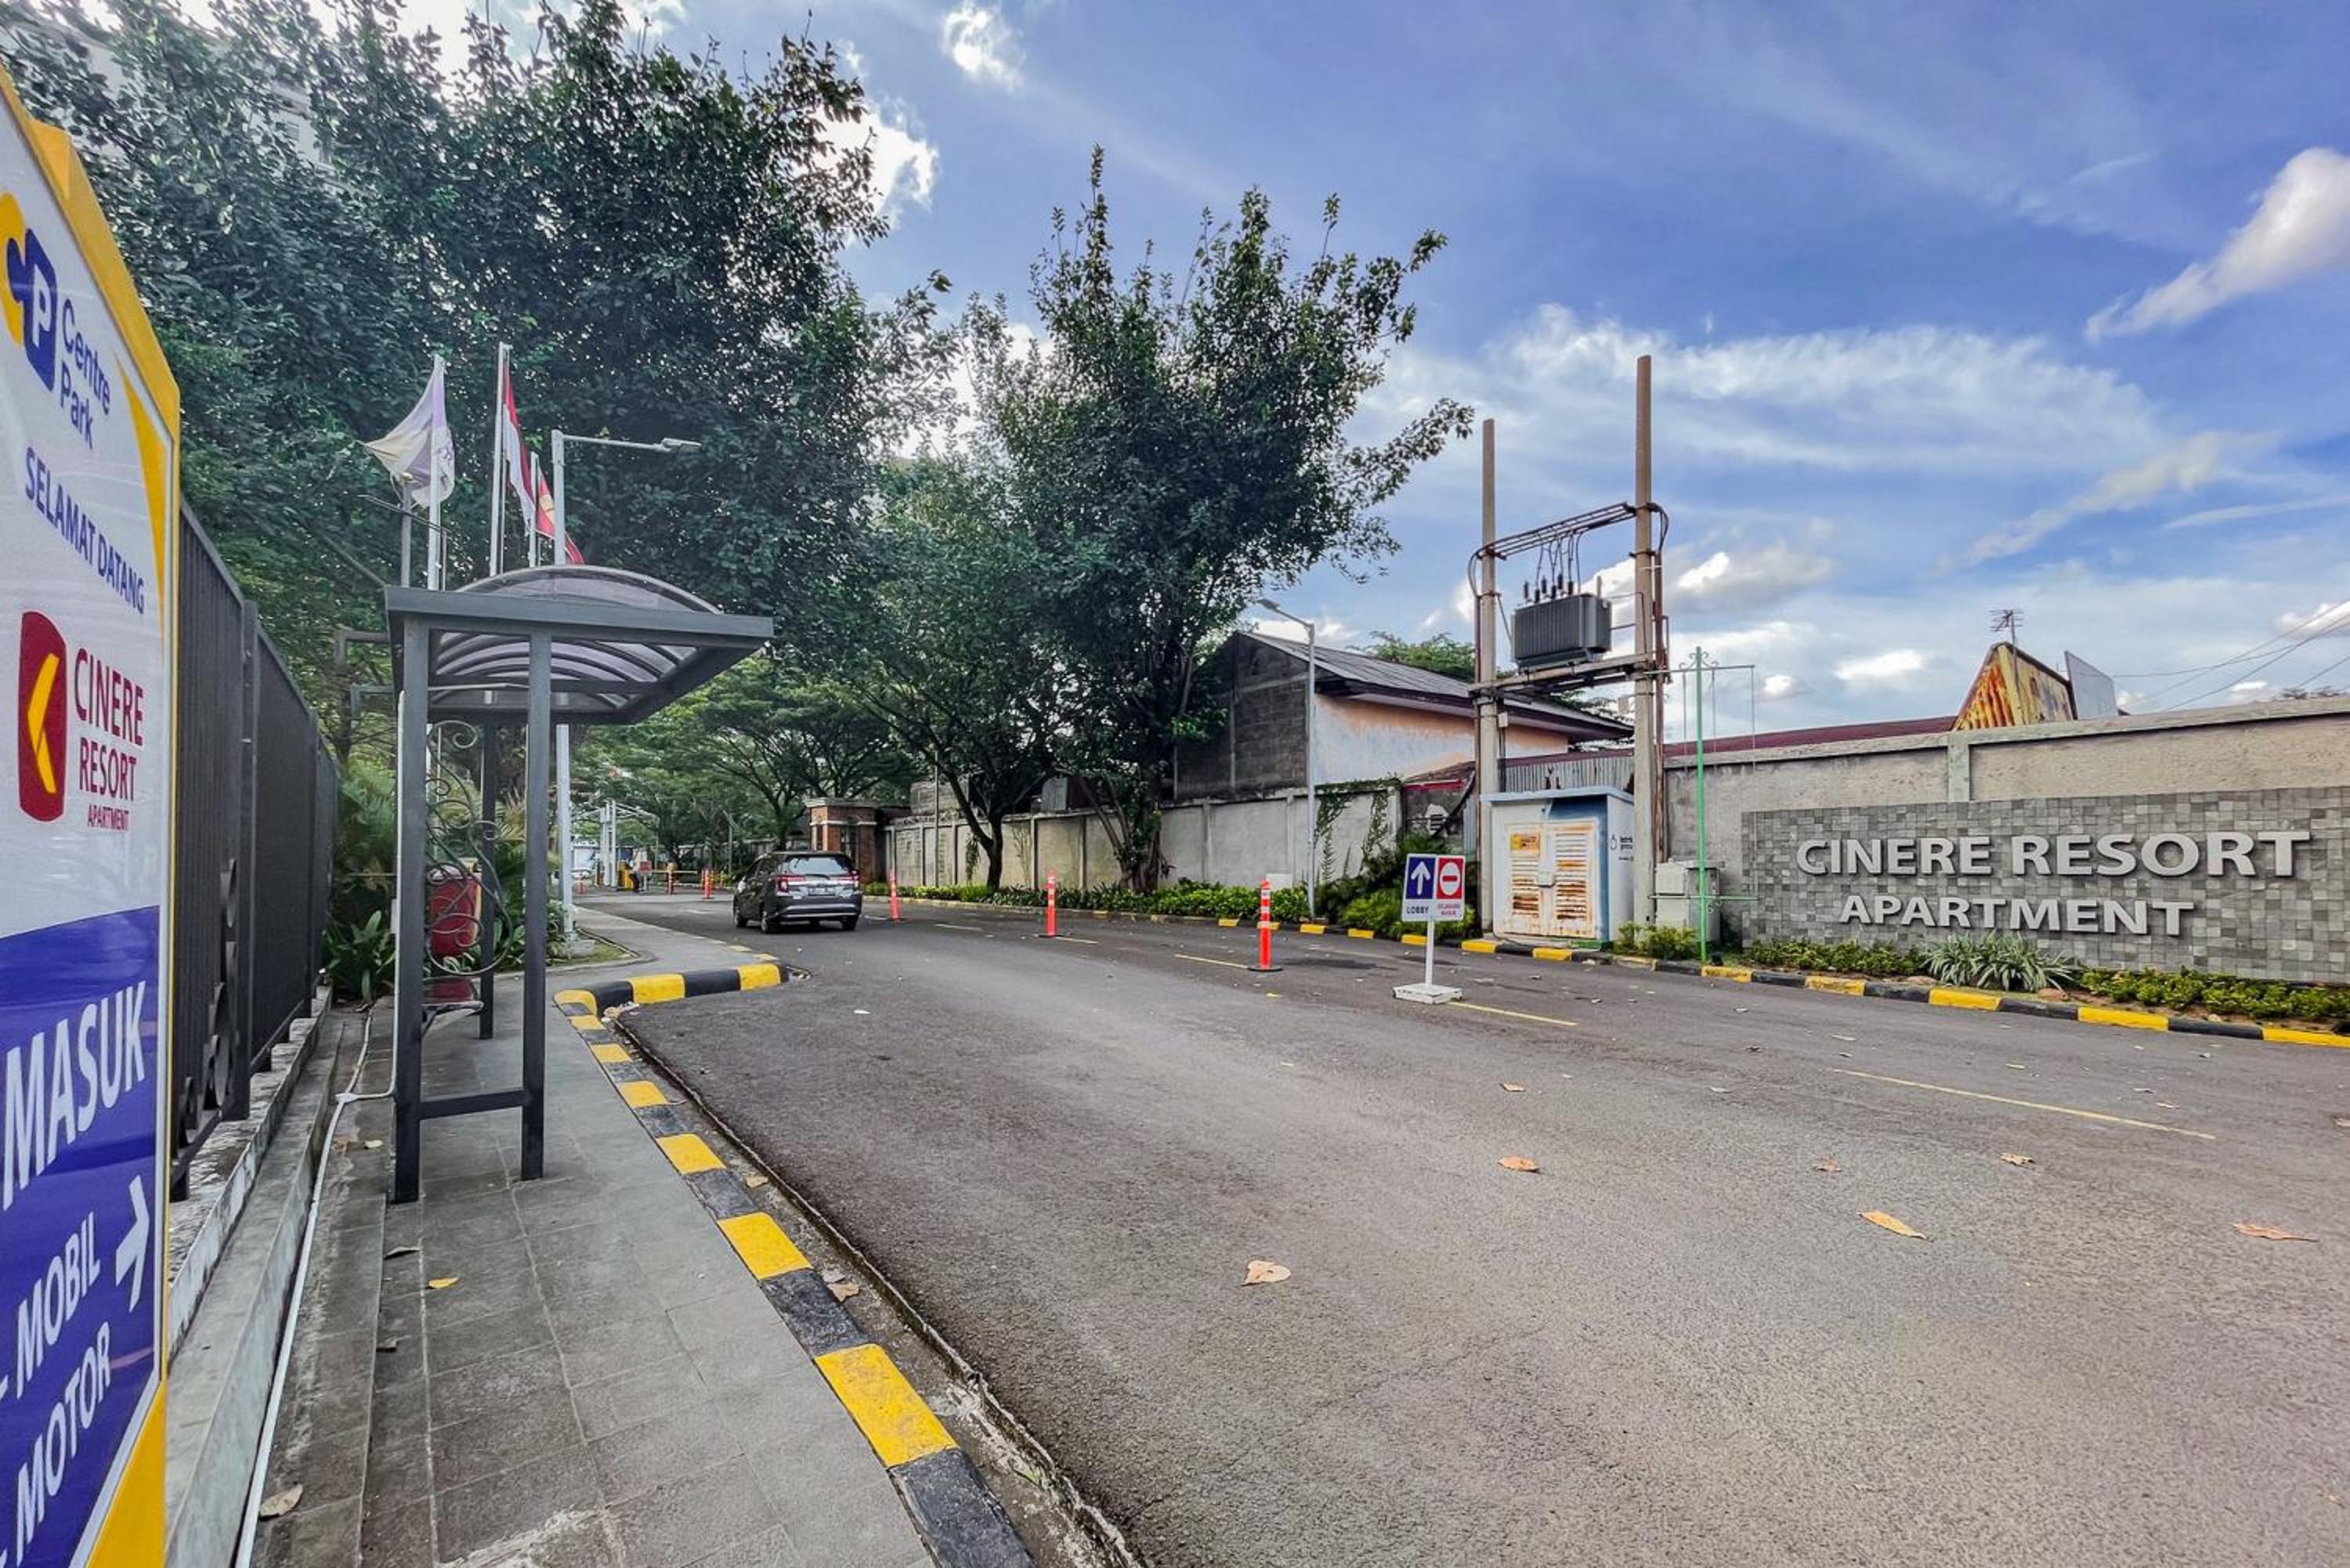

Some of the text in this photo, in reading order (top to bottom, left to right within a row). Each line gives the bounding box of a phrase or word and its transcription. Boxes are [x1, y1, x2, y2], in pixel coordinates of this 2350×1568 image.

[62, 298, 110, 416] Centre
[60, 362, 93, 450] Park
[25, 446, 144, 615] SELAMAT DATANG
[74, 648, 144, 746] CINERE
[79, 737, 137, 801] RESORT
[88, 804, 129, 831] APARTMENT
[1797, 830, 2311, 878] CINERE RESORT
[1406, 905, 1430, 915] LOBBY
[1839, 894, 2194, 936] APARTMENT
[3, 981, 146, 1212] MASUK
[16, 1211, 101, 1400] MOBIL
[16, 1321, 111, 1567] MOTOR
